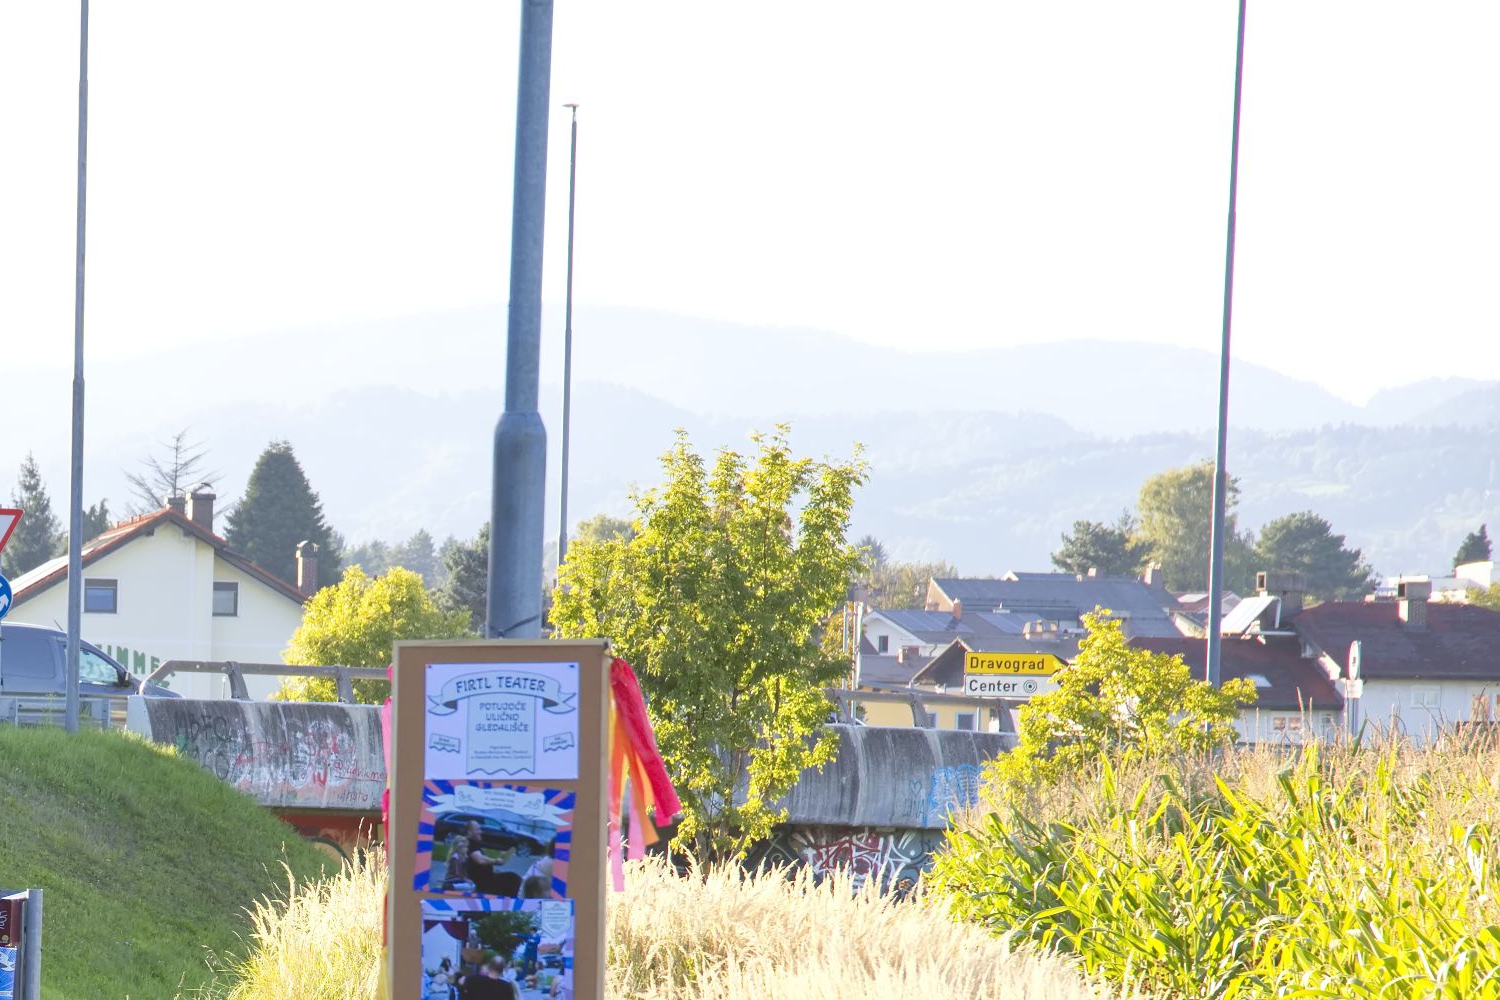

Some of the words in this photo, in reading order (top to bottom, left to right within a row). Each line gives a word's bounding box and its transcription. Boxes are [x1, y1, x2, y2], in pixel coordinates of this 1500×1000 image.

[970, 656, 1045, 673] Dravograd
[456, 677, 492, 693] FIRTL
[496, 676, 546, 692] TEATER
[969, 679, 1018, 692] Center
